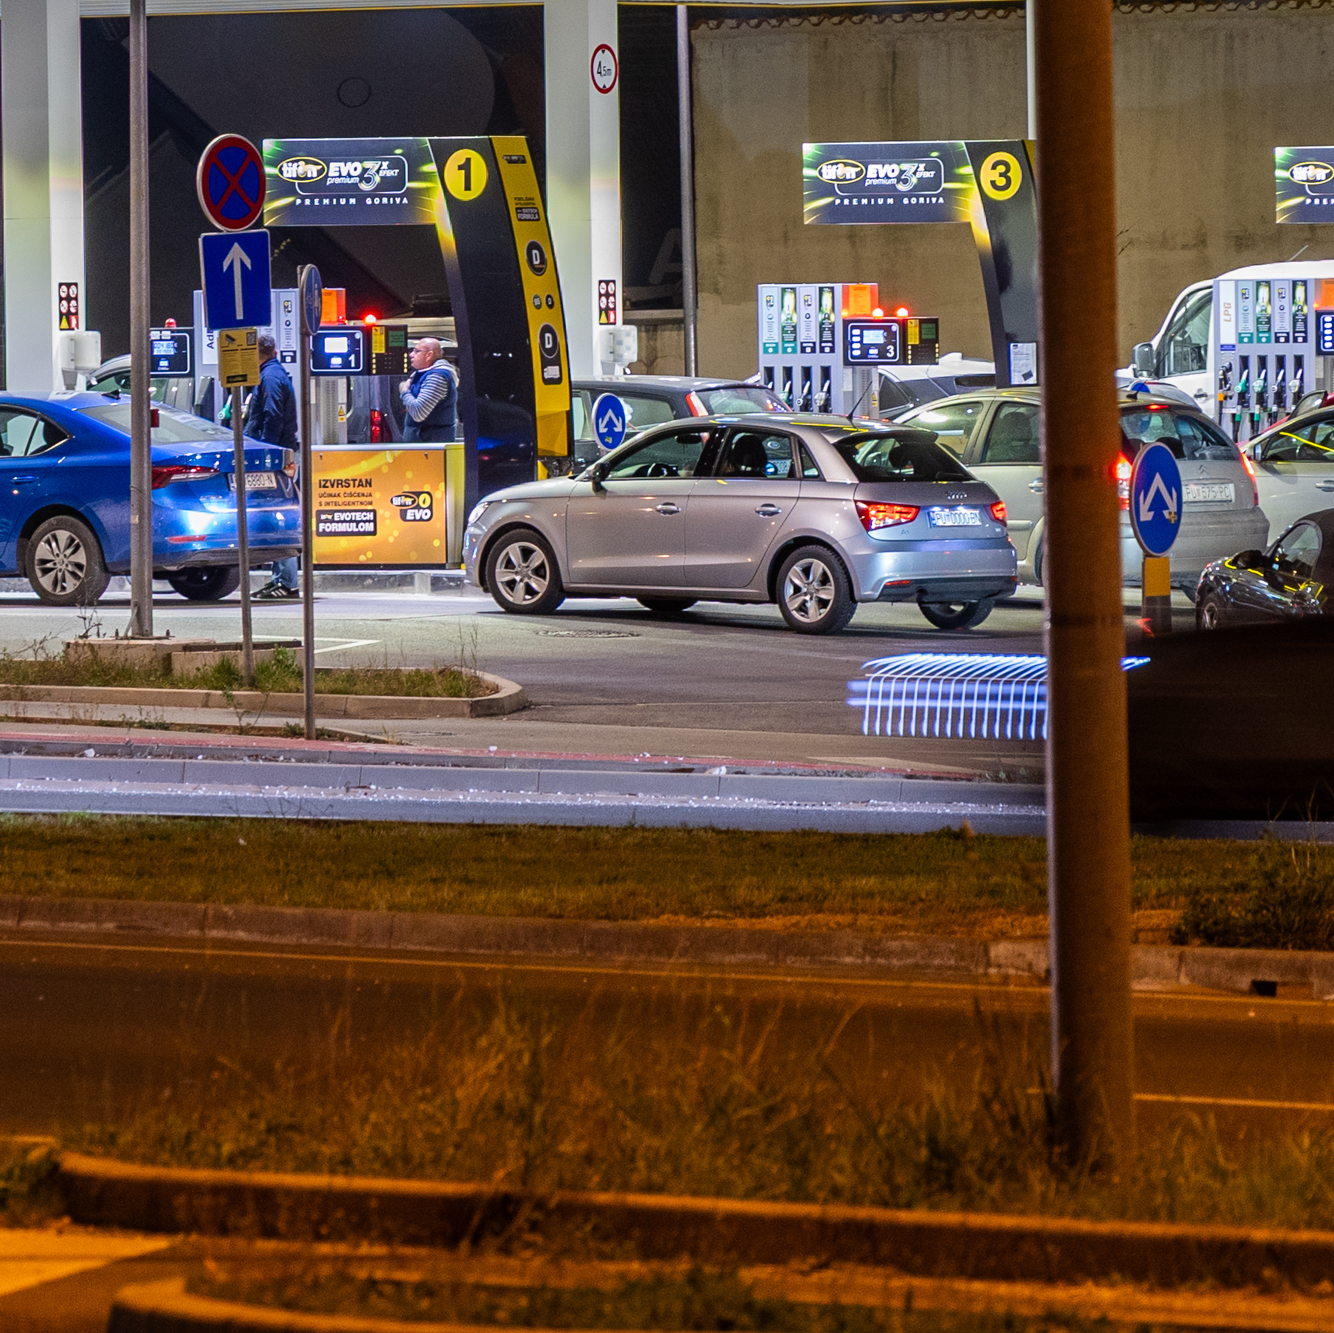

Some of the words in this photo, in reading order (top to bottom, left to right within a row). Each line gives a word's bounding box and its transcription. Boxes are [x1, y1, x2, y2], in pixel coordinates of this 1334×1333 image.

[282, 160, 323, 178] tifon
[328, 162, 362, 176] EVO
[457, 157, 472, 191] 1
[867, 164, 900, 178] EVO
[990, 159, 1013, 191] 3
[326, 177, 359, 185] premium
[865, 178, 897, 186] premium
[295, 198, 357, 206] PREMIUM
[366, 197, 408, 205] GORIVA
[532, 250, 540, 265] D
[1223, 302, 1232, 322] LPG
[545, 333, 553, 348] D
[886, 346, 894, 357] 3
[348, 354, 355, 367] 1
[319, 478, 372, 488] IZVRSTAN
[1186, 487, 1196, 499] PU
[334, 512, 374, 520] EVOTECH
[406, 509, 431, 520] EVO
[319, 523, 374, 532] FORMULOM
